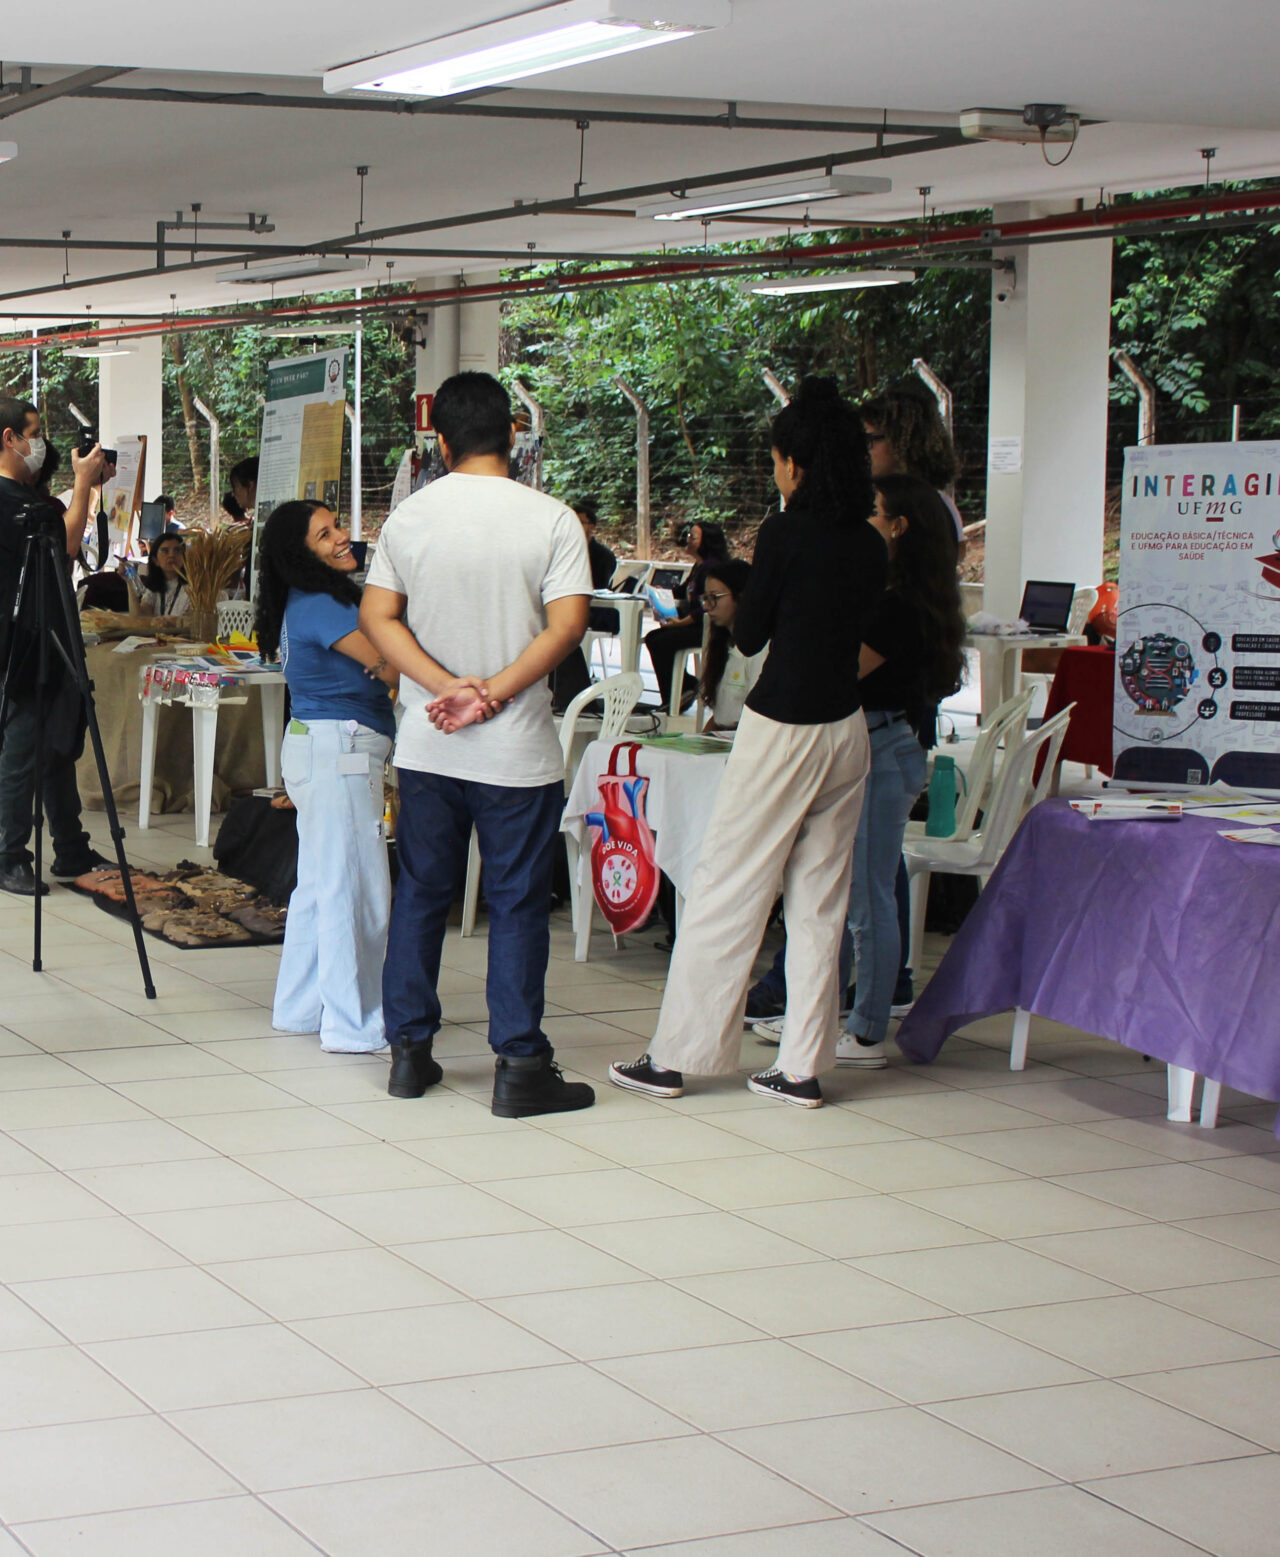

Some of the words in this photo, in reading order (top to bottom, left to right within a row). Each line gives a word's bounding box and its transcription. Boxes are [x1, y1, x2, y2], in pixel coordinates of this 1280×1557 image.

[1133, 473, 1280, 497] INTERAGI
[1131, 531, 1180, 543] EDUCAÇÃO
[1182, 531, 1254, 541] BÁSICA/TÉCNICA
[1190, 542, 1238, 552] EDUCAÇÃO
[1178, 551, 1205, 560] SAÚDE
[617, 841, 638, 857] VIDA
